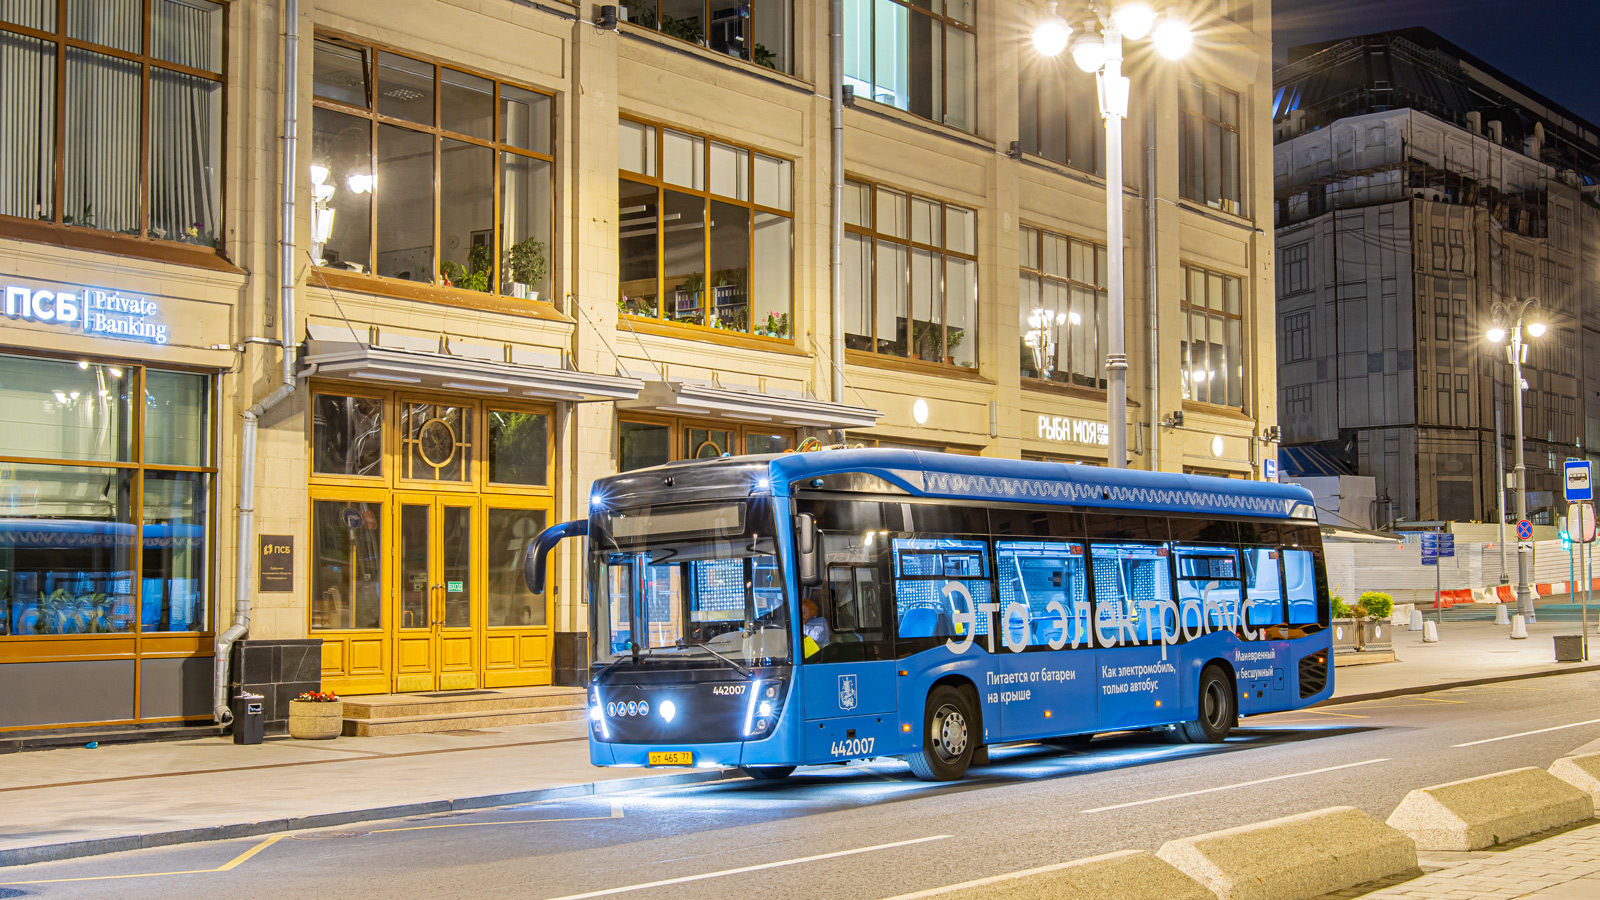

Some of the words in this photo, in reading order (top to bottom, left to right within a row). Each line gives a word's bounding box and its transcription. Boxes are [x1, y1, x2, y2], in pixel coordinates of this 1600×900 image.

[5, 286, 78, 322] ПСБ
[92, 290, 157, 316] Private
[92, 313, 167, 344] Banking
[1038, 415, 1071, 441] РЫБА
[1073, 419, 1097, 444] МОЯ
[274, 545, 291, 554] ПСБ
[942, 581, 1030, 655] Это
[1235, 648, 1276, 663] Маневренный
[986, 671, 1028, 686] Питается
[1030, 672, 1040, 683] от
[1041, 667, 1076, 684] батареи
[1102, 665, 1117, 678] Как
[1118, 660, 1176, 678] электромобиль,
[1240, 665, 1274, 681] бесшумный
[713, 685, 746, 696] 442007
[1102, 683, 1129, 695] только
[1130, 677, 1159, 693] автобус
[987, 692, 999, 704] на
[1000, 689, 1032, 705] крыше
[830, 737, 875, 758] 442007
[664, 753, 679, 763] 465
[682, 752, 690, 760] 77
